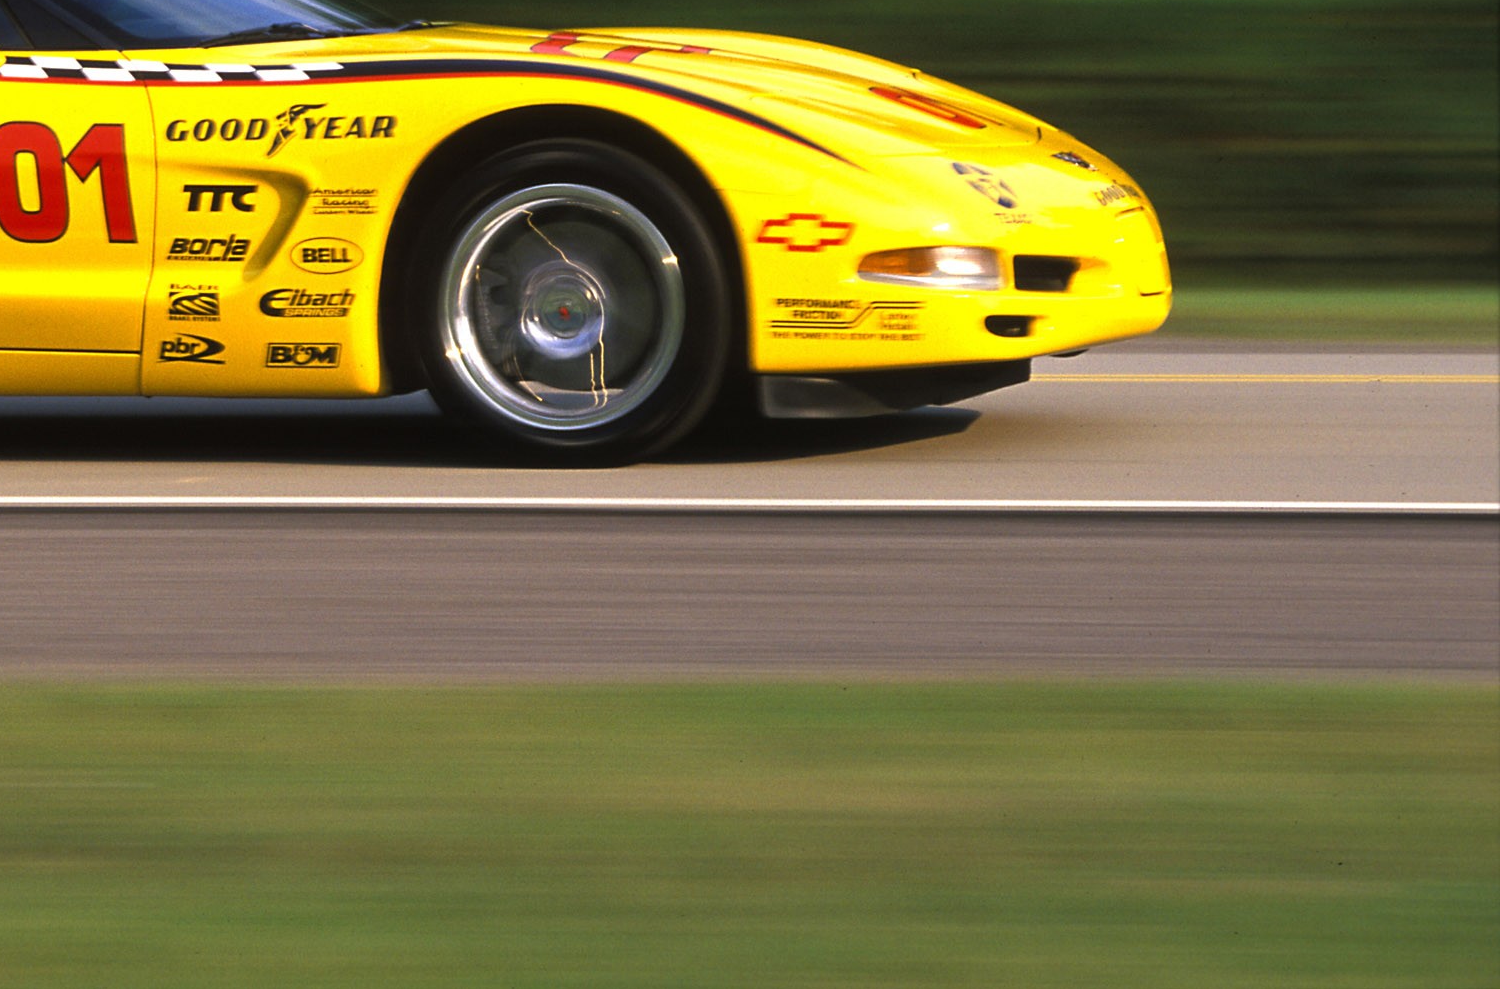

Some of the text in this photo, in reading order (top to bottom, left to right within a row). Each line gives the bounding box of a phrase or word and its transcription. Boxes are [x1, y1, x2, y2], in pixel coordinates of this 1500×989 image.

[183, 185, 258, 212] TTC
[302, 247, 353, 263] BELL
[284, 308, 344, 317] SPRINGS
[160, 339, 200, 361] pbr
[267, 345, 338, 365] B&M
